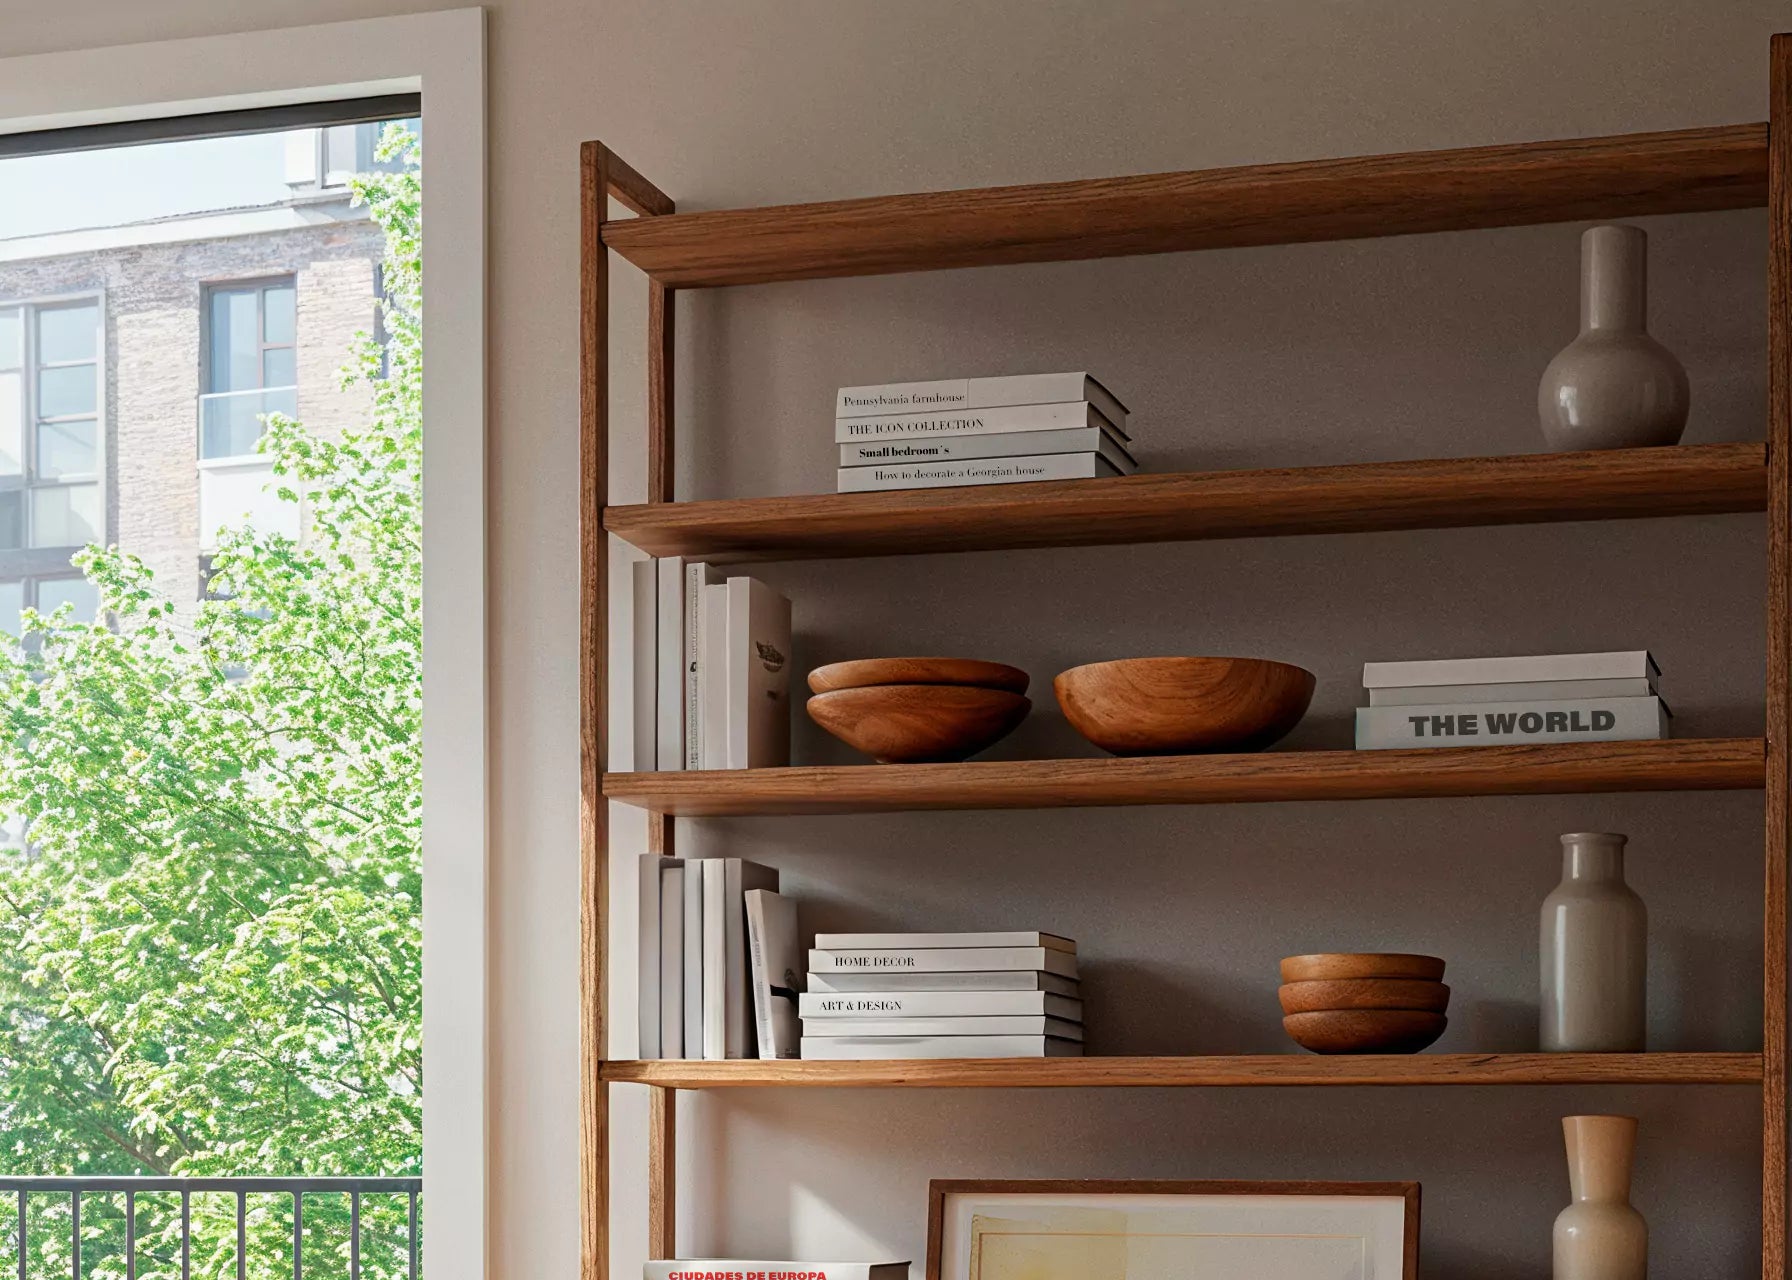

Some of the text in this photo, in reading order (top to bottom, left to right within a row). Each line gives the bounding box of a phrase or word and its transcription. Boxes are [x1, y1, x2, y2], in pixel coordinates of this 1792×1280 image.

[844, 392, 965, 408] Pennsylvania farmhouse
[848, 419, 984, 435] THE ICON COLLECTION
[859, 447, 890, 458] Small
[875, 470, 899, 480] How
[902, 470, 912, 479] to
[914, 467, 955, 478] decorate
[967, 466, 1012, 479] Georgian
[1015, 465, 1045, 475] house
[1408, 710, 1616, 737] THE WORLD
[835, 957, 915, 967] HOME DECOR
[820, 1001, 902, 1011] ART & DESIGN
[668, 1271, 827, 1280] CIUDADES DE EUROPA
